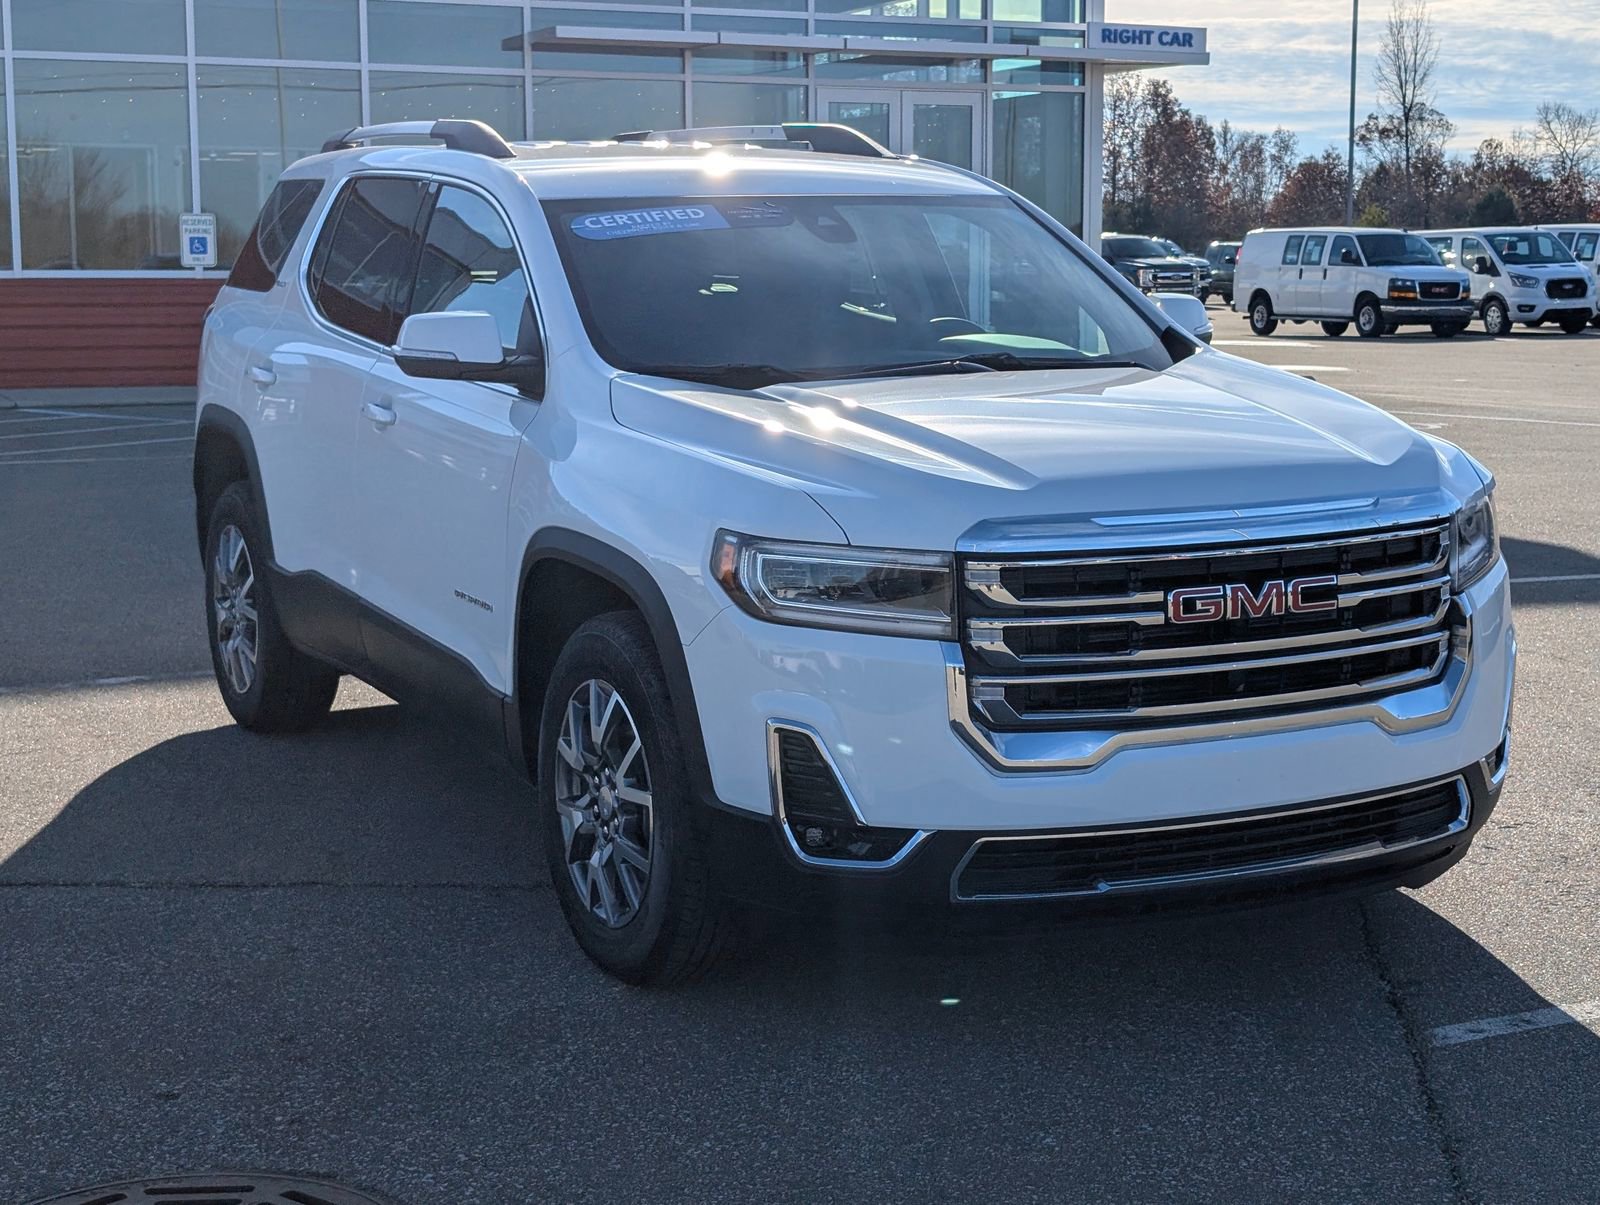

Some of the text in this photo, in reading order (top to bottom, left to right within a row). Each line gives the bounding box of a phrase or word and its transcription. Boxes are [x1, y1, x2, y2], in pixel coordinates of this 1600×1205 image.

[1101, 28, 1193, 48] RIGHT CAR
[181, 218, 213, 226] RESERVED
[584, 207, 705, 229] CERTIFIED
[184, 227, 212, 235] PARKING
[1168, 574, 1338, 624] GMC
